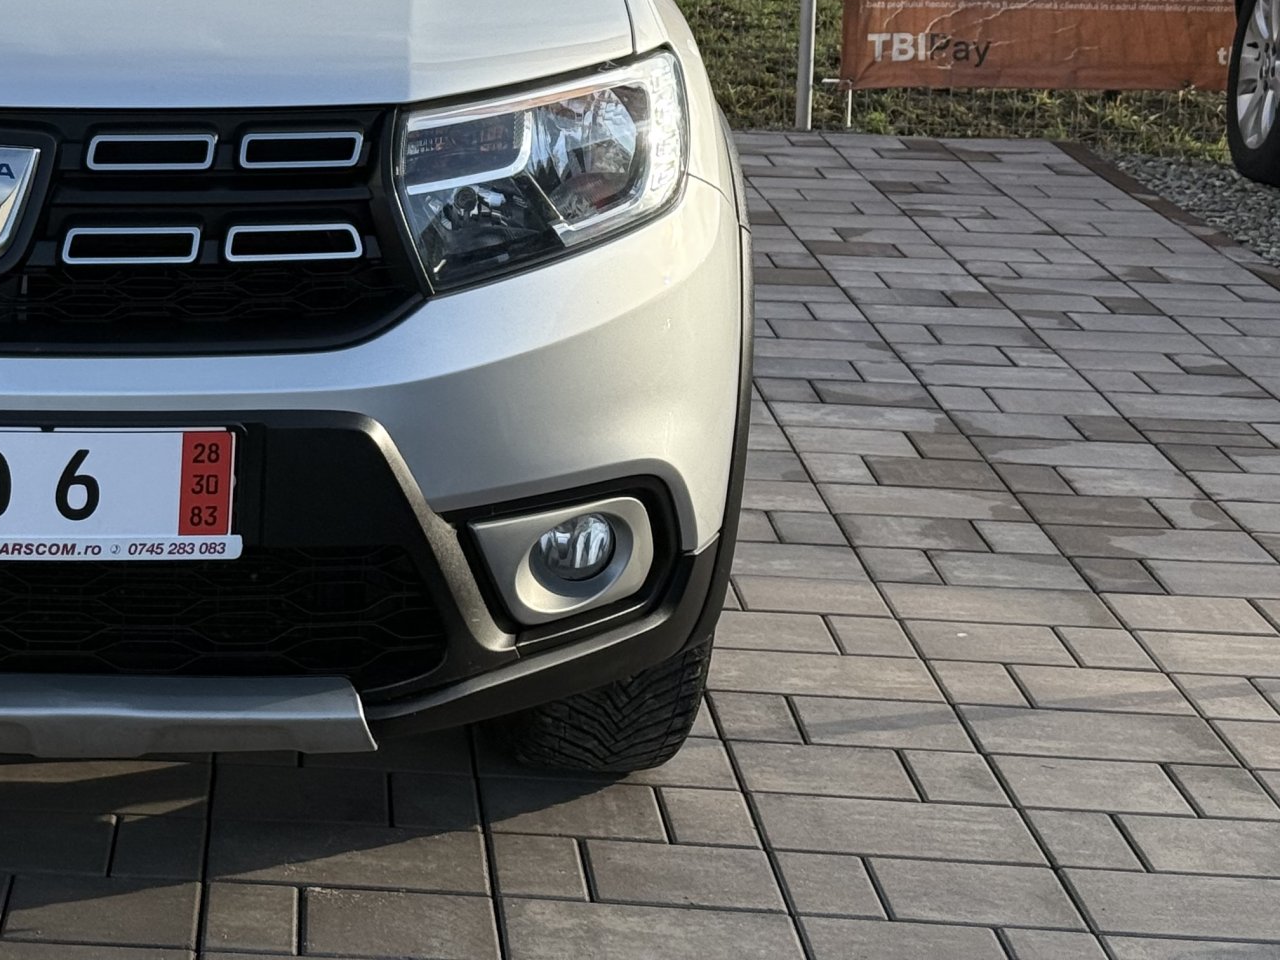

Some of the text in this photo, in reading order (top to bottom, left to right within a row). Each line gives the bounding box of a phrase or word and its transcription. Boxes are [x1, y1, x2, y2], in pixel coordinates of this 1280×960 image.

[192, 443, 220, 464] 28
[54, 448, 101, 521] 6
[190, 474, 219, 495] 30
[189, 506, 218, 527] 83
[127, 542, 164, 556] 0745
[167, 542, 195, 555] 283
[198, 541, 226, 555] 083
